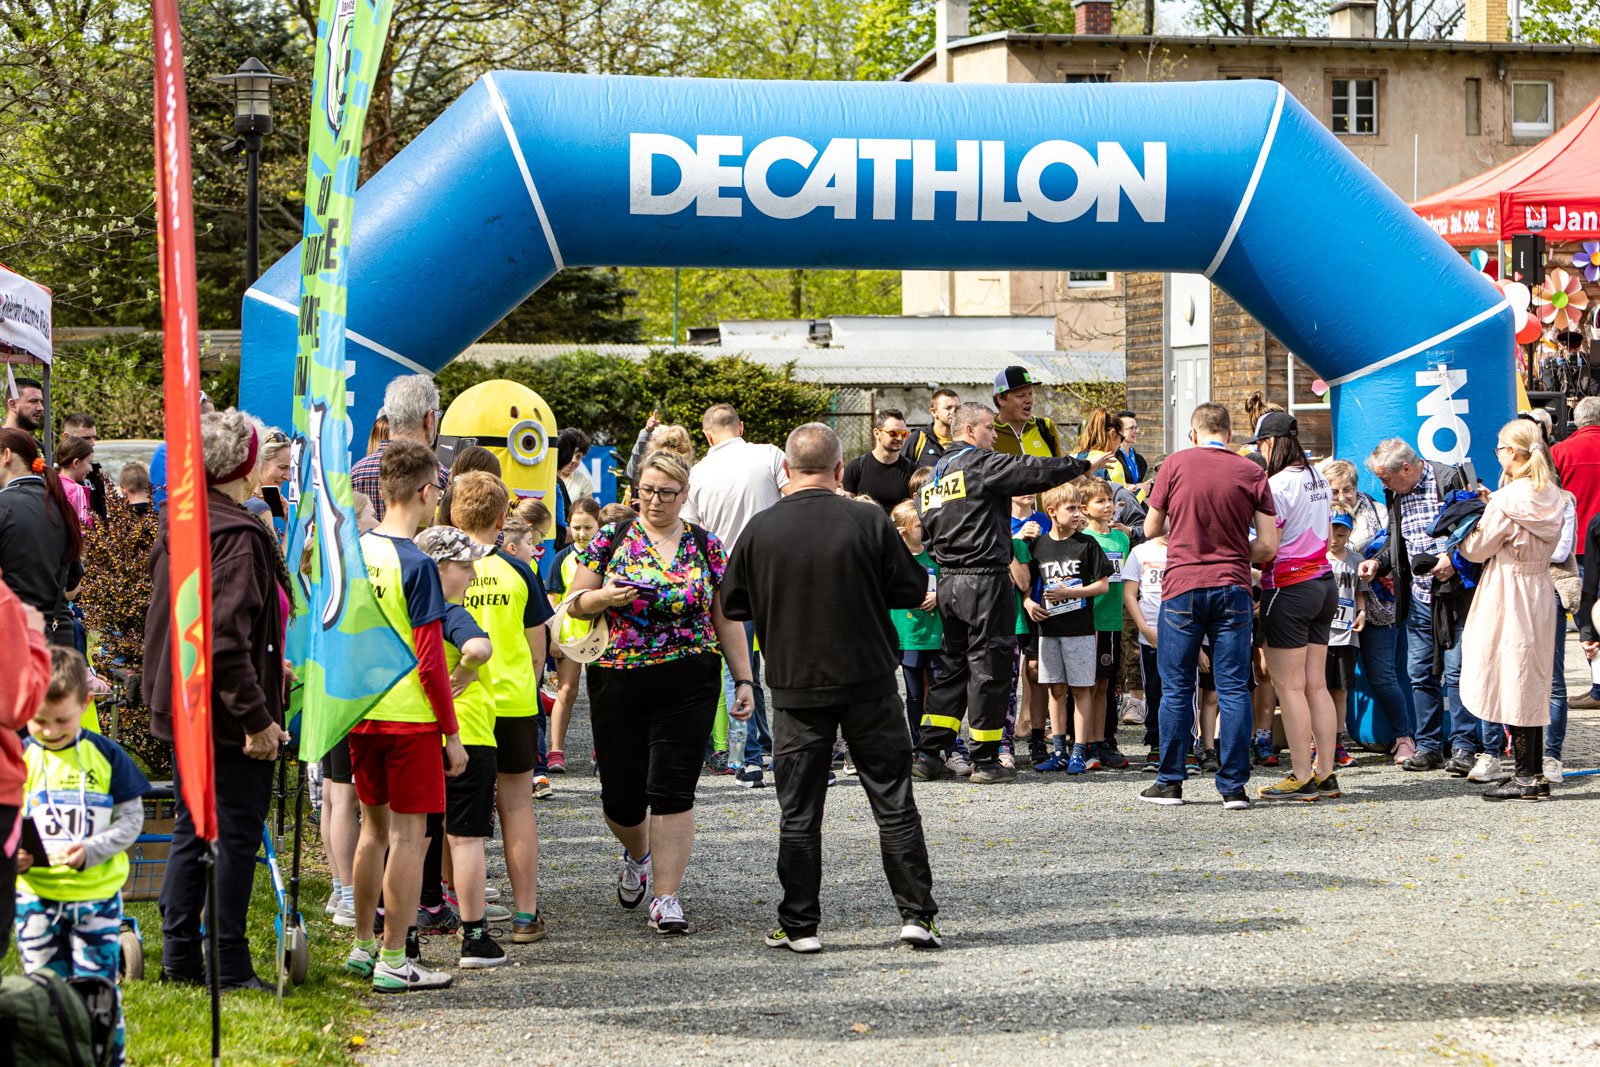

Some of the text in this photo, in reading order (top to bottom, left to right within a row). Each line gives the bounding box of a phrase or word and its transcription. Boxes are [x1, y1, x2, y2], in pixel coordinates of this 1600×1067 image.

[629, 132, 1168, 223] DECATHLON
[1552, 206, 1599, 232] Jan
[1415, 368, 1472, 467] ON
[1042, 560, 1082, 578] TAKE
[45, 807, 95, 838] 316
